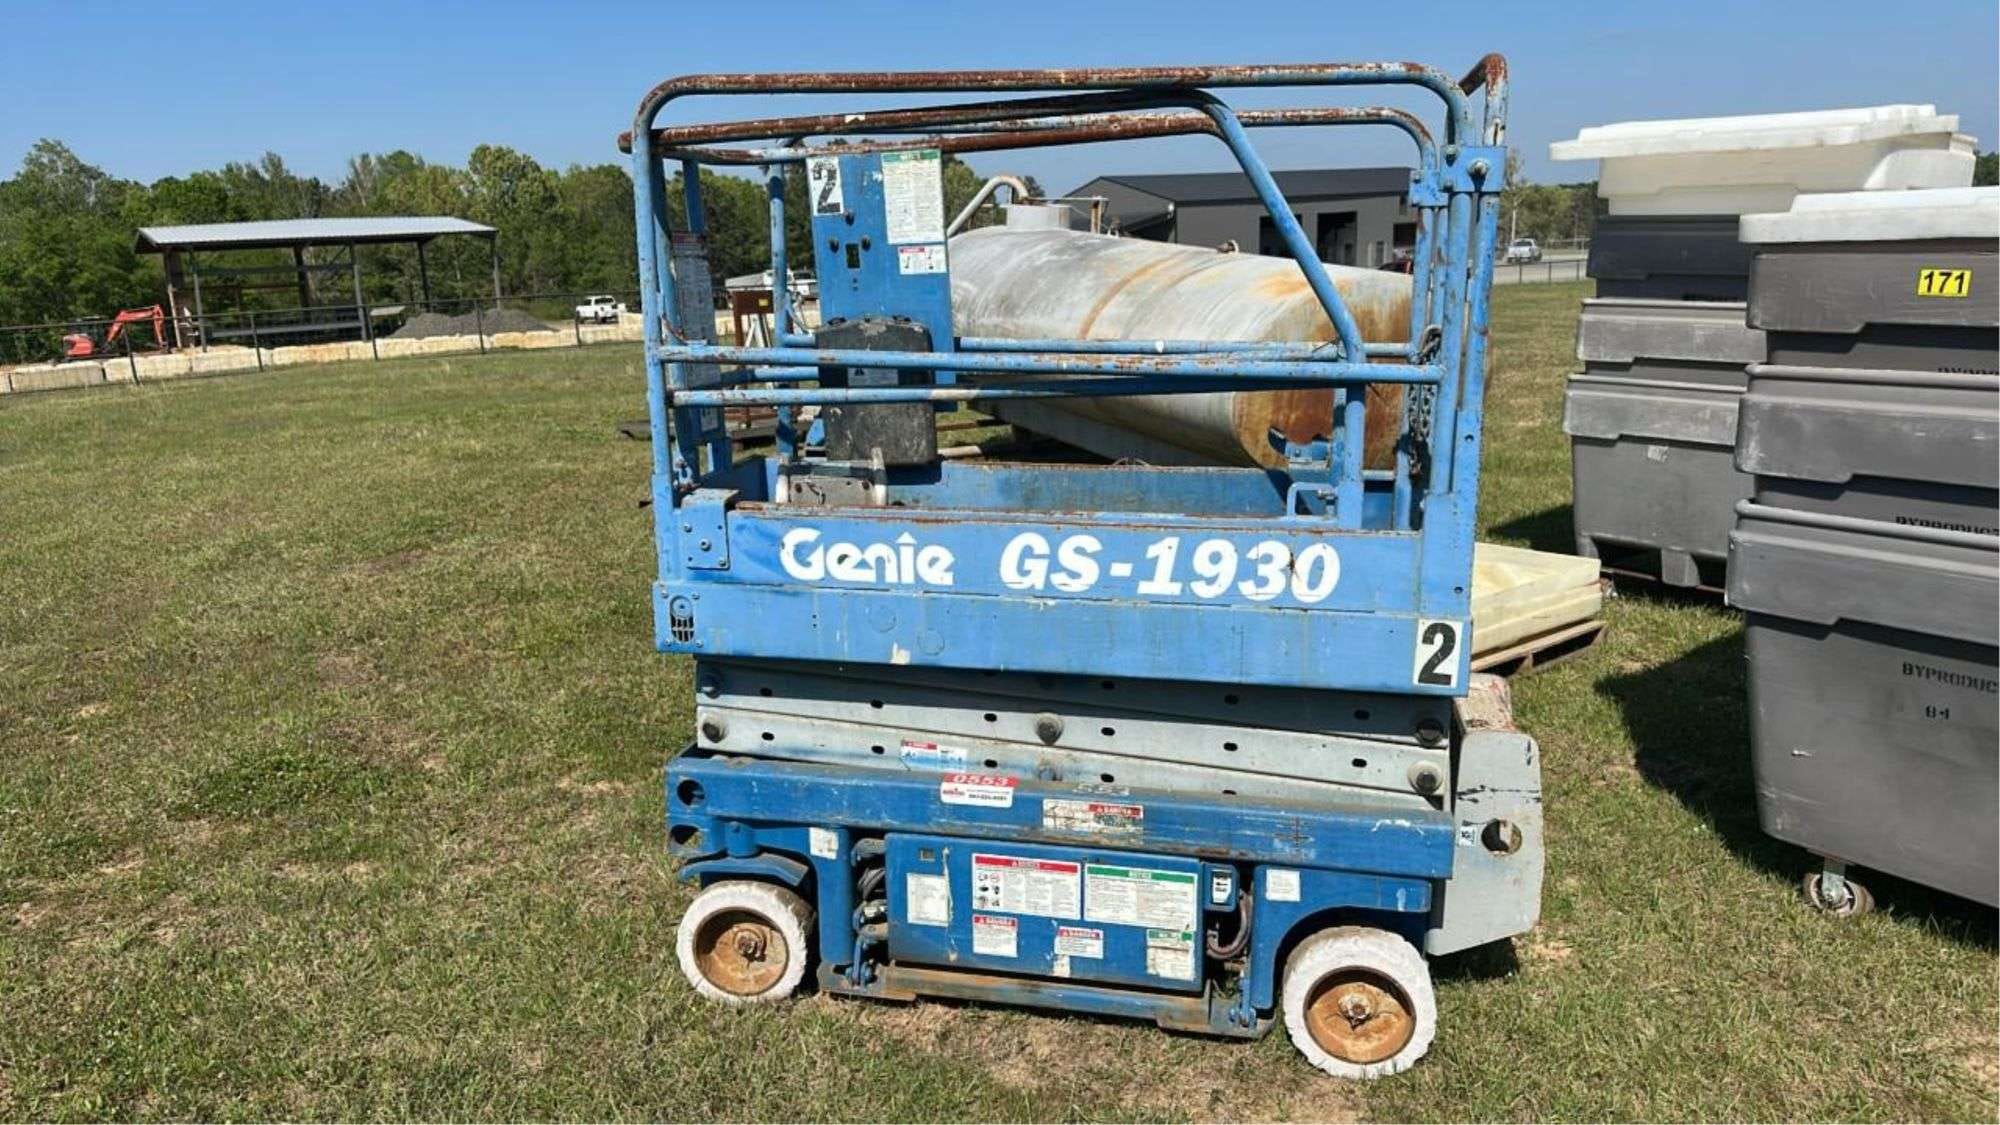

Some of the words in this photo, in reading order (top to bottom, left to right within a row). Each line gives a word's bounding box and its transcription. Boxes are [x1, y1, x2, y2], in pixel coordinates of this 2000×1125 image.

[812, 161, 841, 214] 2
[1924, 270, 1964, 294] 171
[780, 527, 954, 585] Genie
[999, 531, 1342, 603] GS-1930
[1418, 622, 1457, 686] 2
